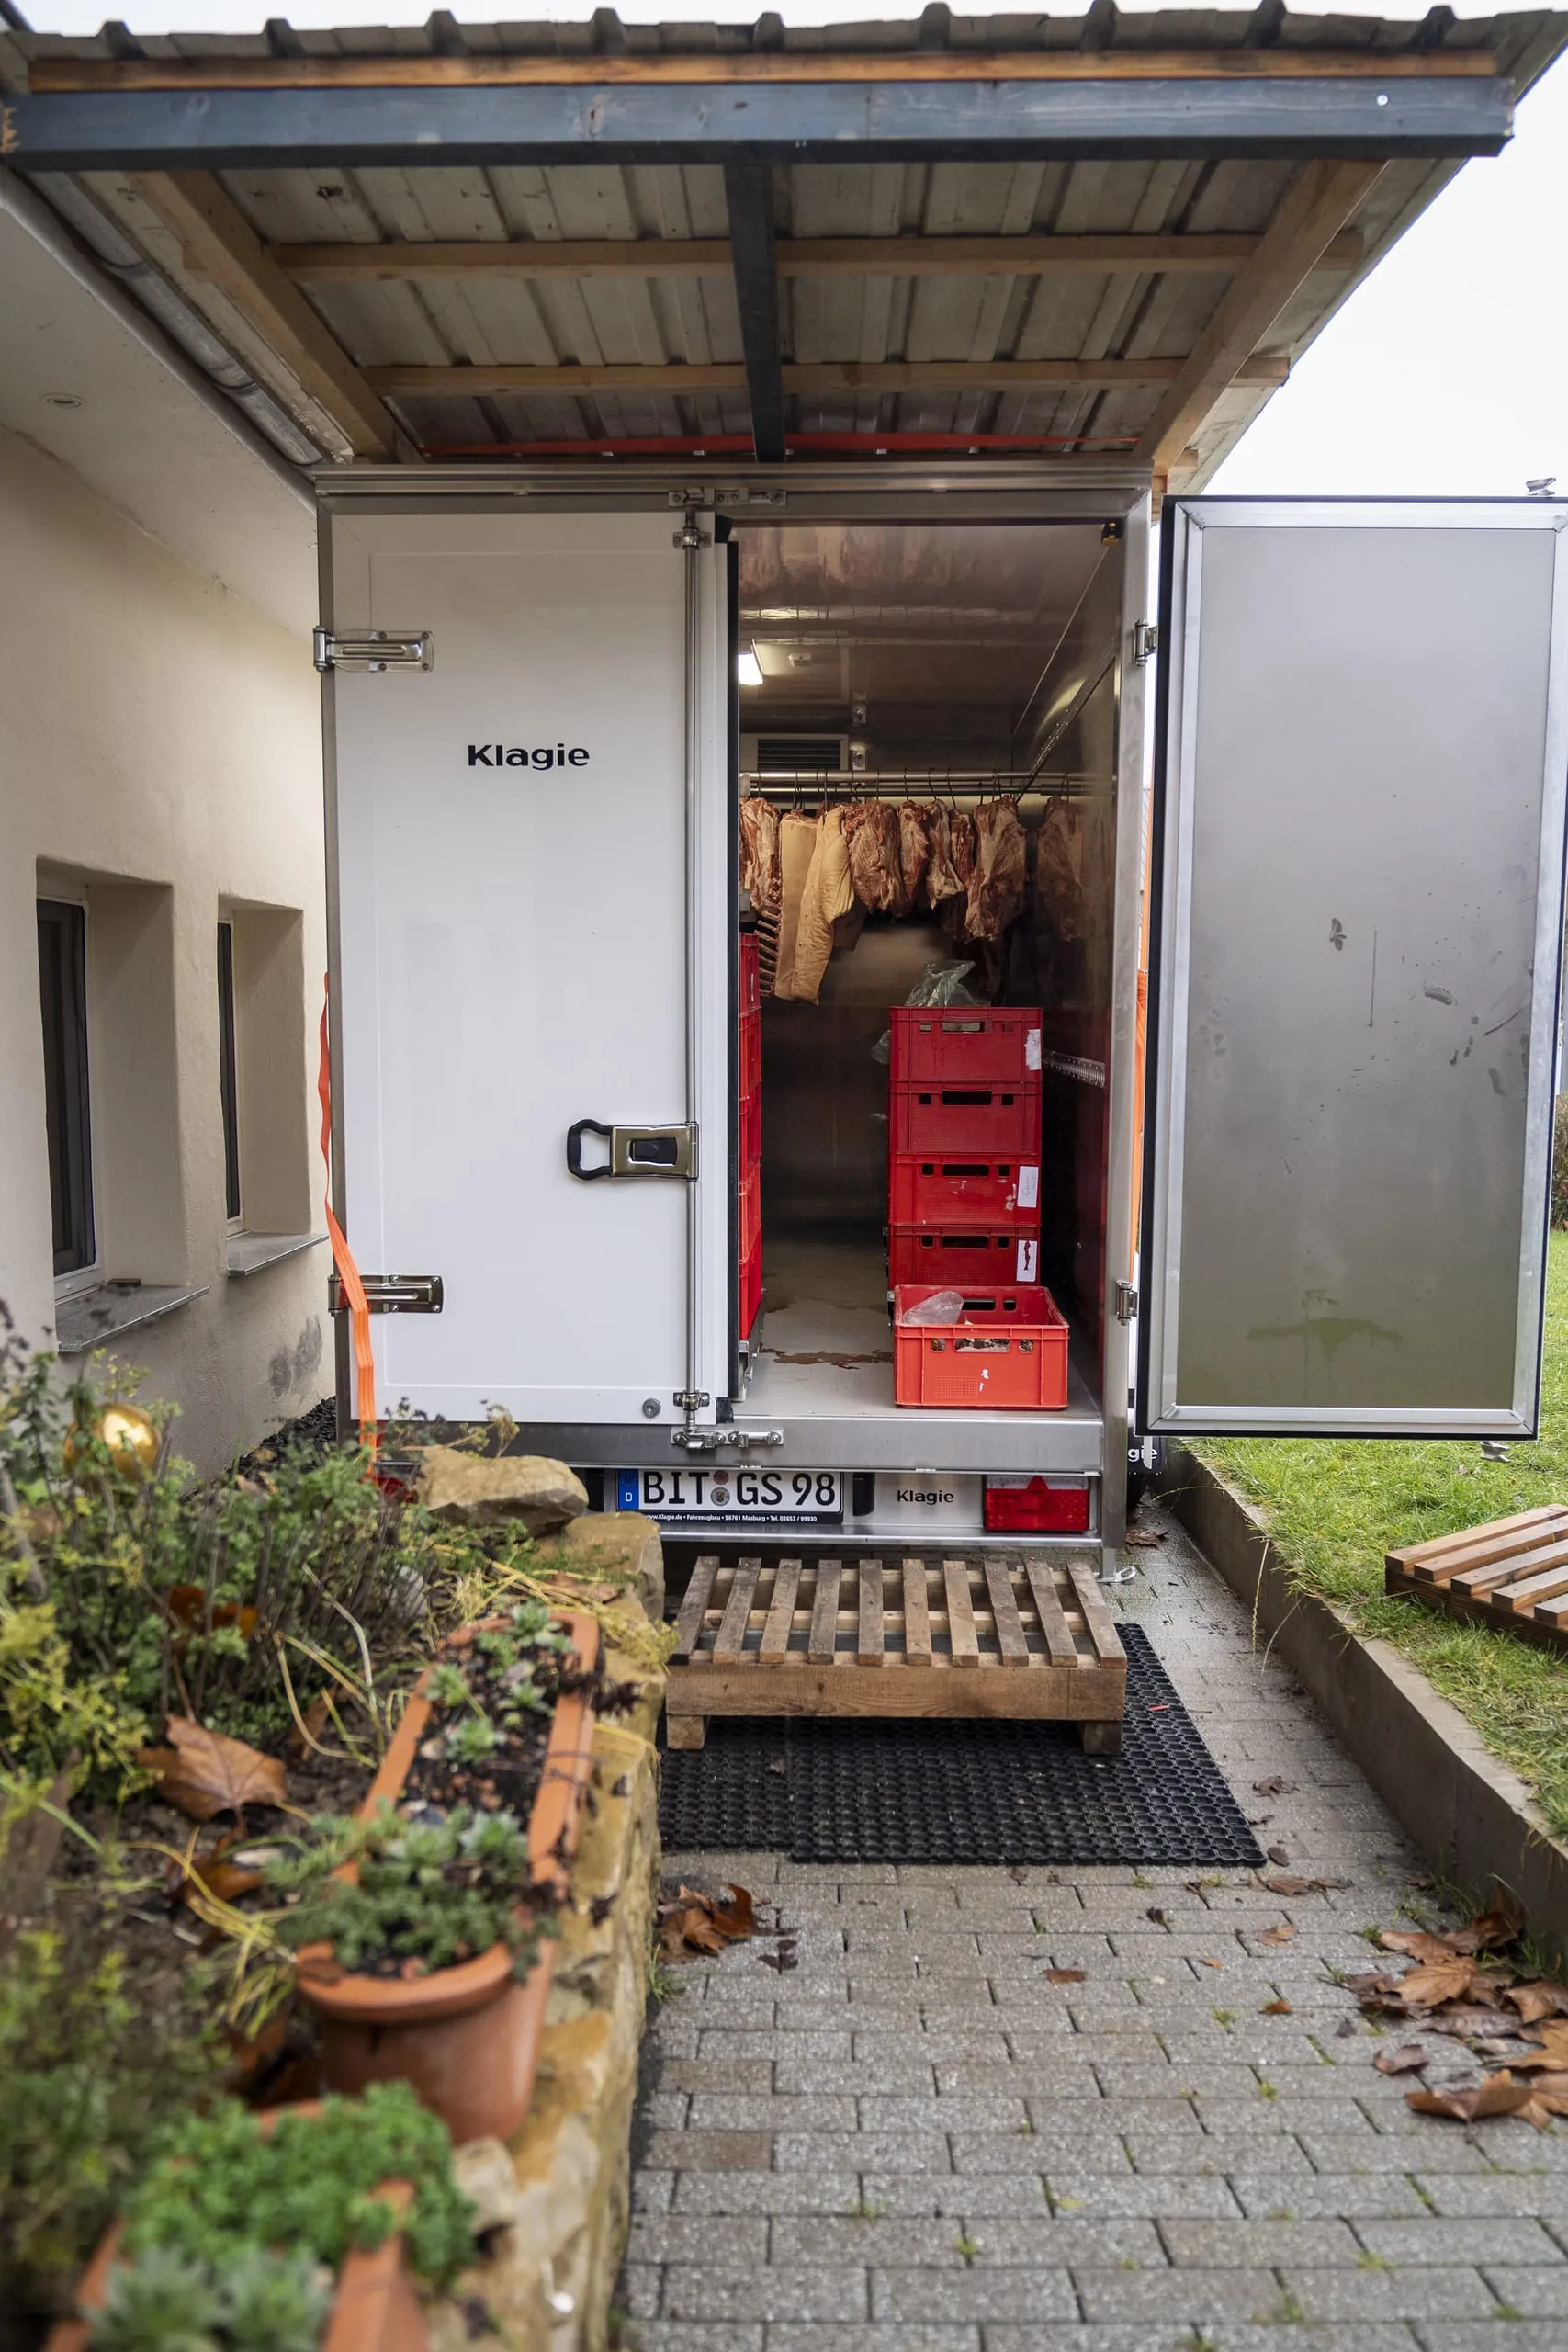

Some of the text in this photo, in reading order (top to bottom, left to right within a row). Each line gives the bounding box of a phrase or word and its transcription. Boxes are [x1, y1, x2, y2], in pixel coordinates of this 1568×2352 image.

[468, 742, 590, 771] Klagie
[1127, 1444, 1158, 1463] gie
[625, 1492, 633, 1502] D
[643, 1471, 836, 1506] BIT GS 98
[897, 1489, 954, 1506] Klagie
[742, 1514, 766, 1522] Masburg
